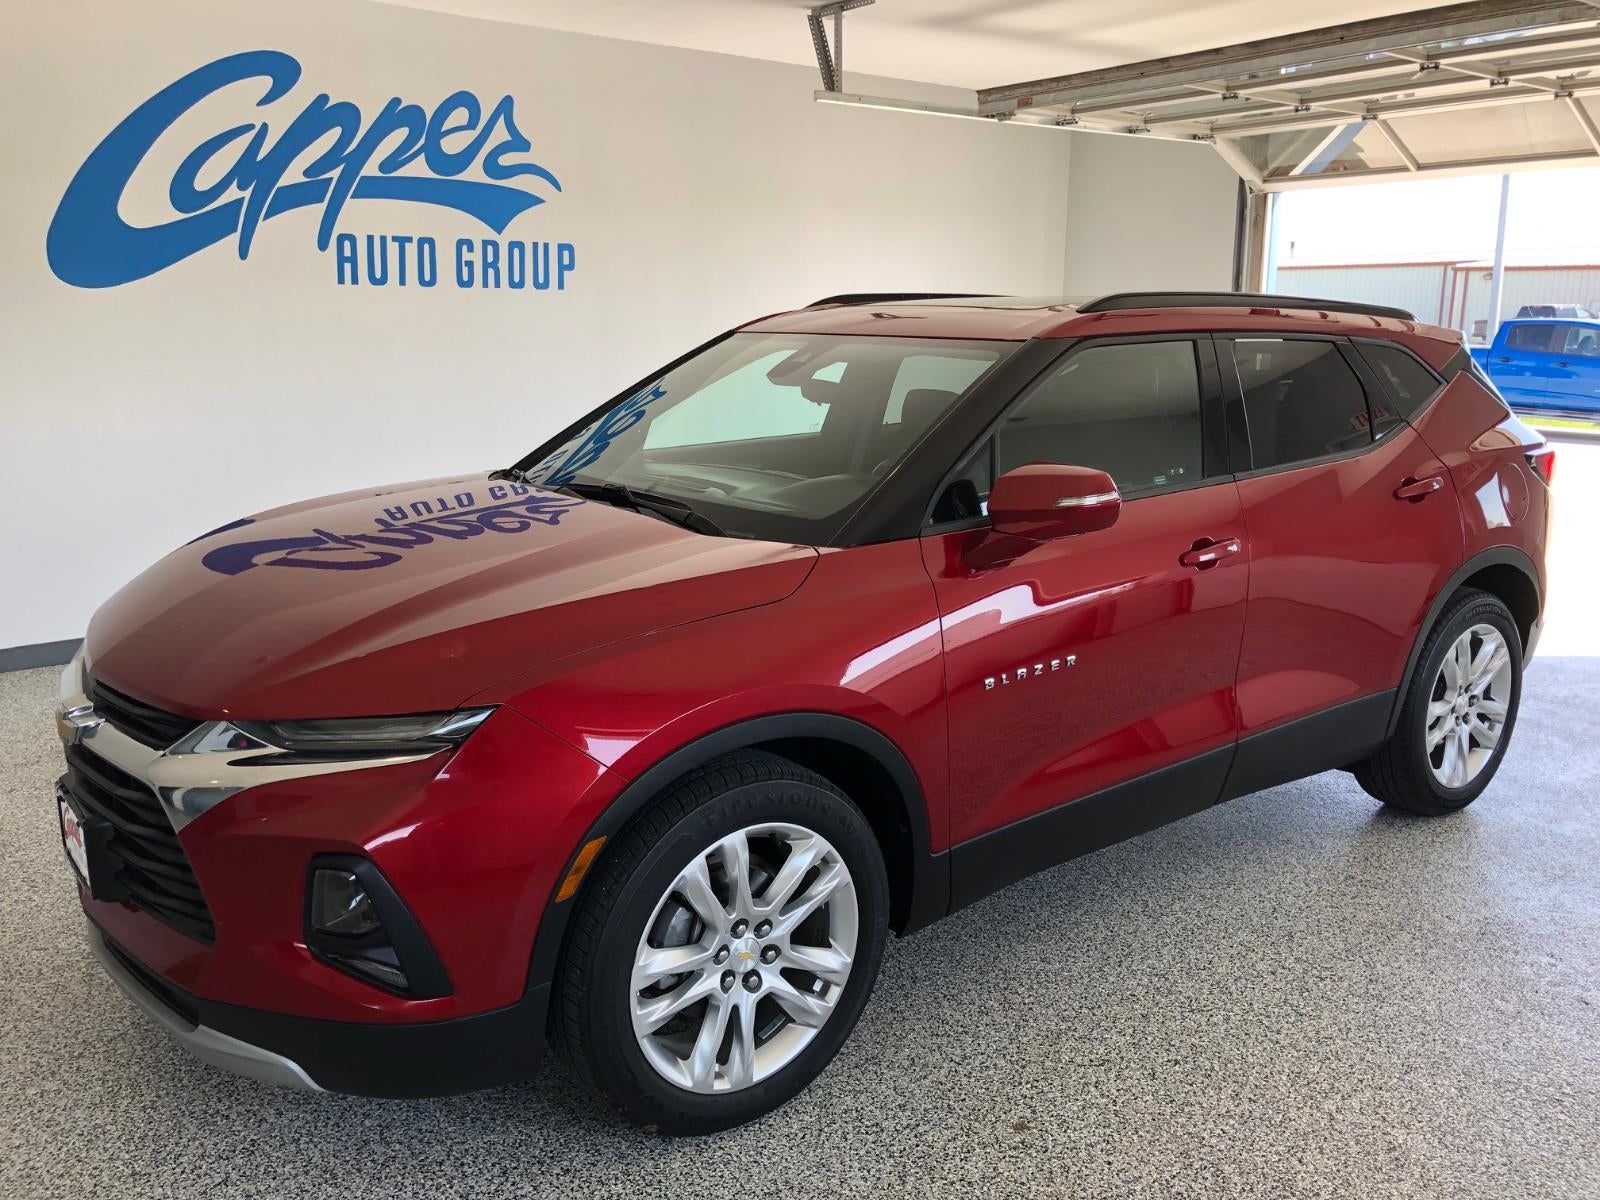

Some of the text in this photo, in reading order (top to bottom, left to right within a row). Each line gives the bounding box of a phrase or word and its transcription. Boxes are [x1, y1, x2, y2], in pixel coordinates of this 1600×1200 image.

[46, 50, 562, 289] Cappes
[336, 233, 576, 291] AUTO GROUP
[984, 655, 1077, 690] BLAZER
